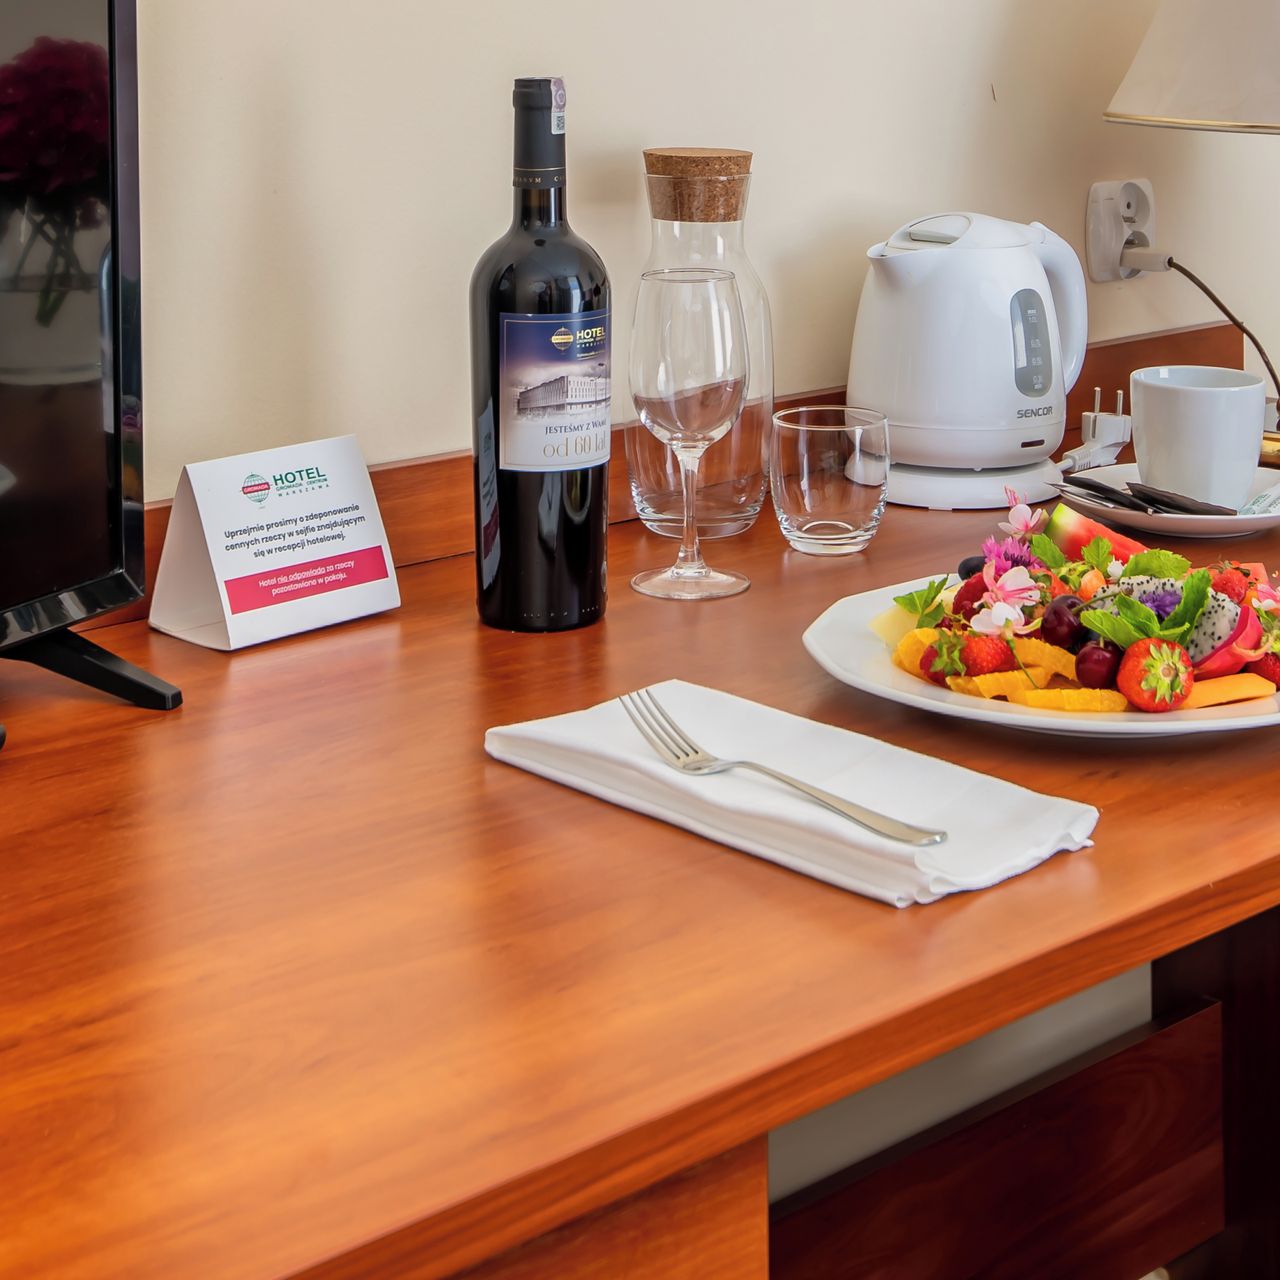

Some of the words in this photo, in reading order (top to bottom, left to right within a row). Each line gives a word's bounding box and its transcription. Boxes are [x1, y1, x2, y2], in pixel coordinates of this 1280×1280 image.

[576, 327, 605, 339] HOTEL
[1017, 406, 1053, 419] SENCOR
[543, 437, 569, 458] od
[575, 435, 591, 456] 60
[272, 467, 326, 486] HOTEL
[275, 482, 304, 492] GROMADA
[243, 483, 269, 494] GROMADA
[278, 484, 330, 497] WARSZAWA
[224, 524, 265, 540] Uprzejmie
[265, 517, 298, 532] prosimy
[305, 503, 360, 522] zdeponowanie
[225, 537, 261, 552] cennych
[261, 531, 286, 545] rzeczy
[296, 524, 316, 538] sejfie
[316, 514, 366, 534] znajdującym
[253, 549, 266, 559] się
[266, 548, 274, 556] w
[274, 539, 306, 555] recepcji
[306, 531, 346, 548] hotelowej.
[259, 576, 277, 588] Hotel
[277, 575, 288, 585] nie
[289, 566, 326, 582] odpowiada
[326, 565, 335, 573] za
[335, 560, 355, 572] rzeczy
[271, 580, 317, 597] pozostawione
[317, 577, 325, 585] w
[324, 572, 348, 586] pokoju.
